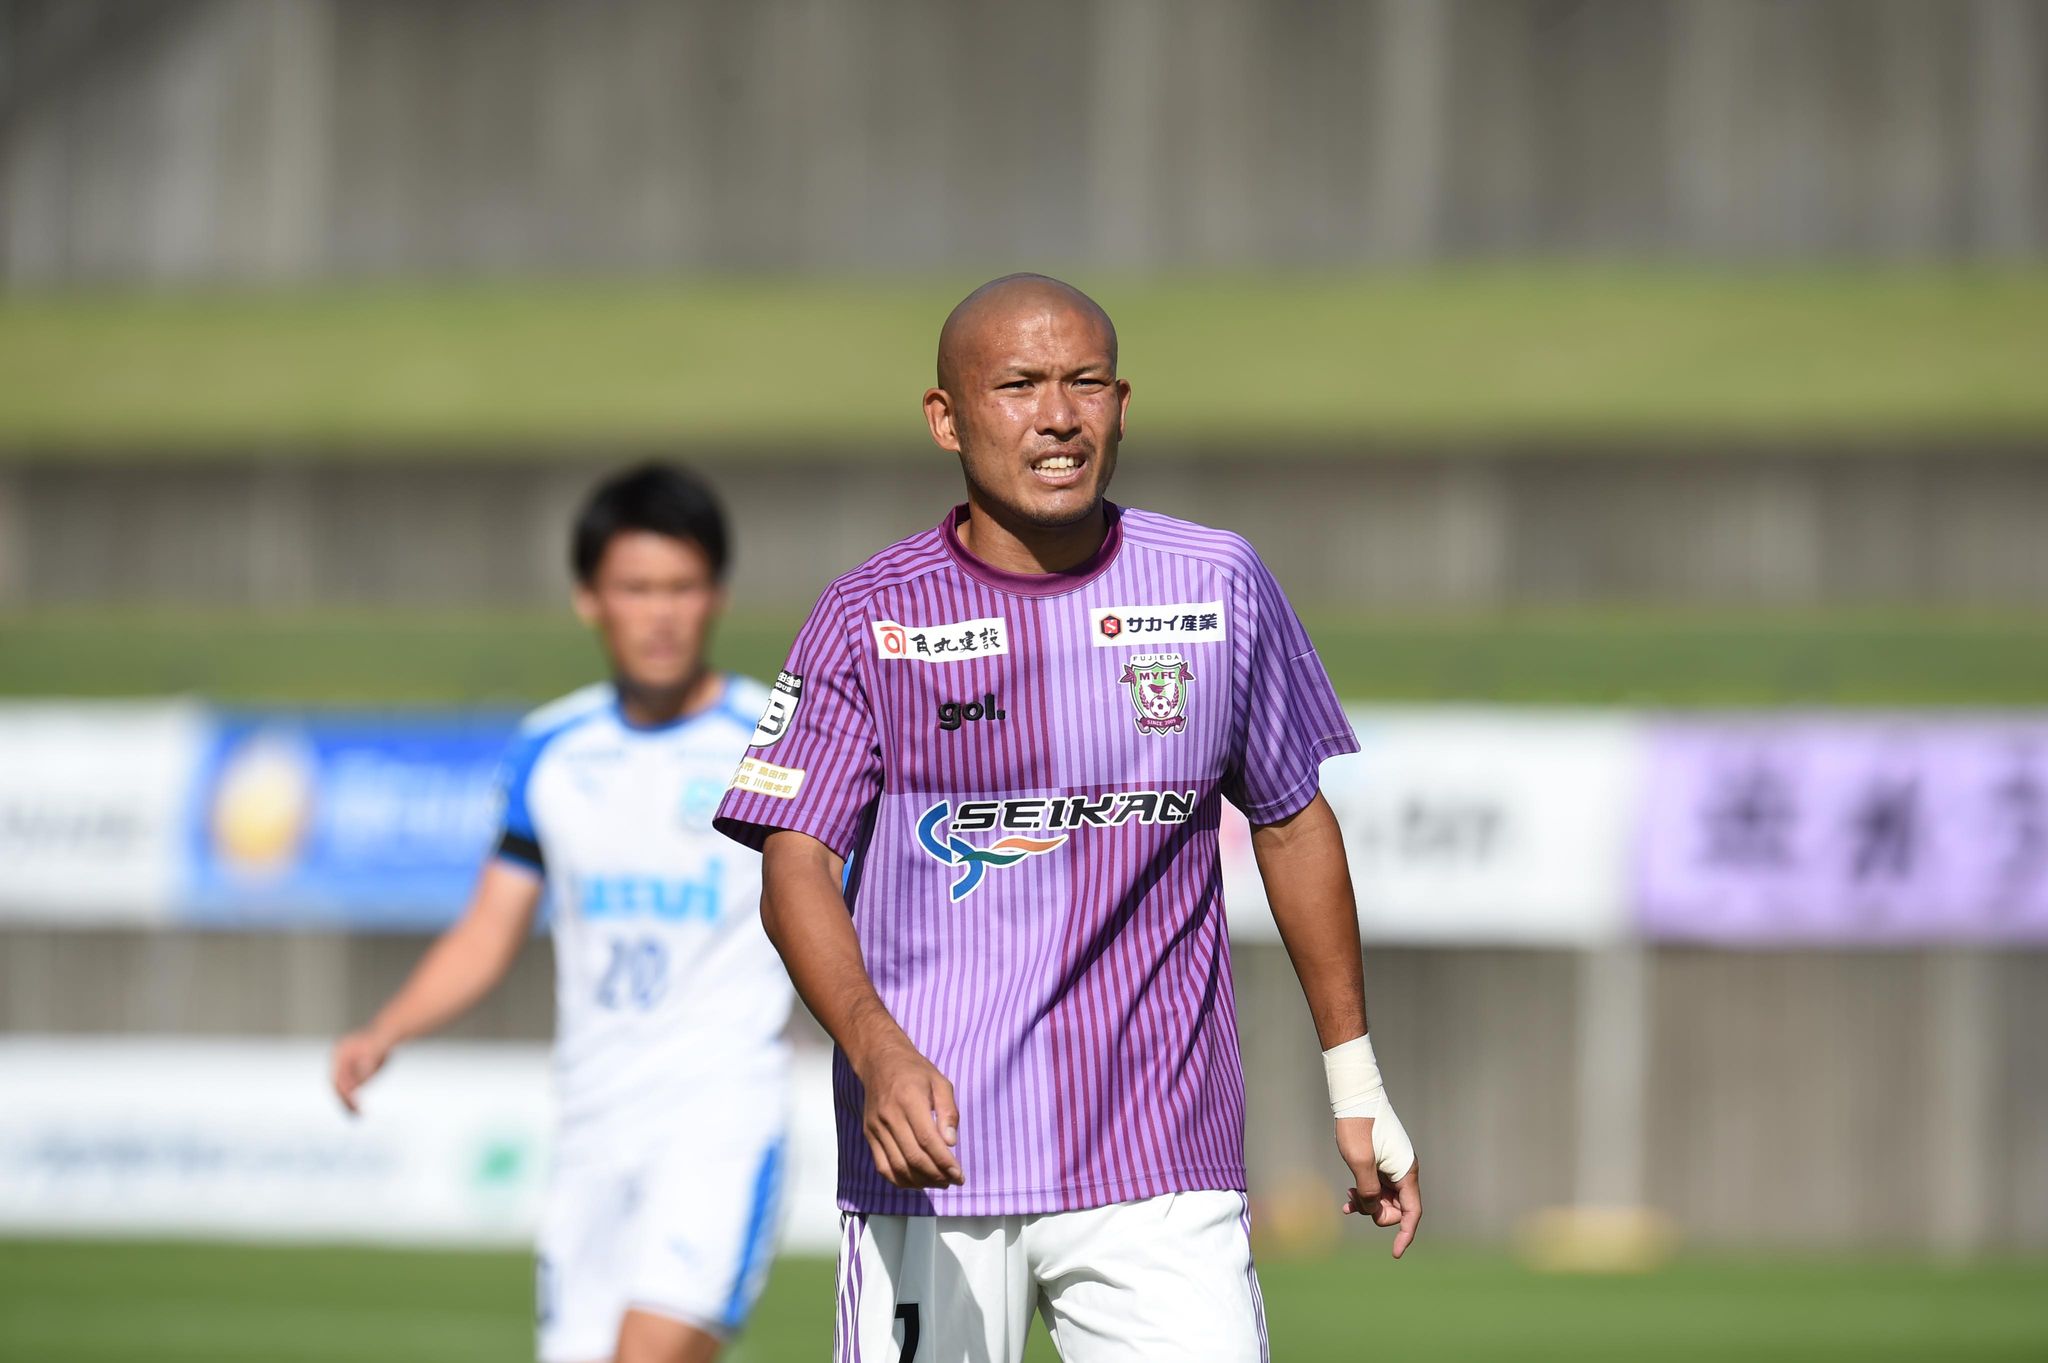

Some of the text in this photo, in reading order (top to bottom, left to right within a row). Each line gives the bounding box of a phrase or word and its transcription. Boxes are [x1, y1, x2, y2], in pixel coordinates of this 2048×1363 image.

[1126, 613, 1218, 633] サカイ産業
[910, 627, 1001, 656] 角丸建設
[1139, 671, 1177, 680] MYFC
[938, 694, 1006, 731] gol.
[951, 792, 1196, 830] SEIKAN
